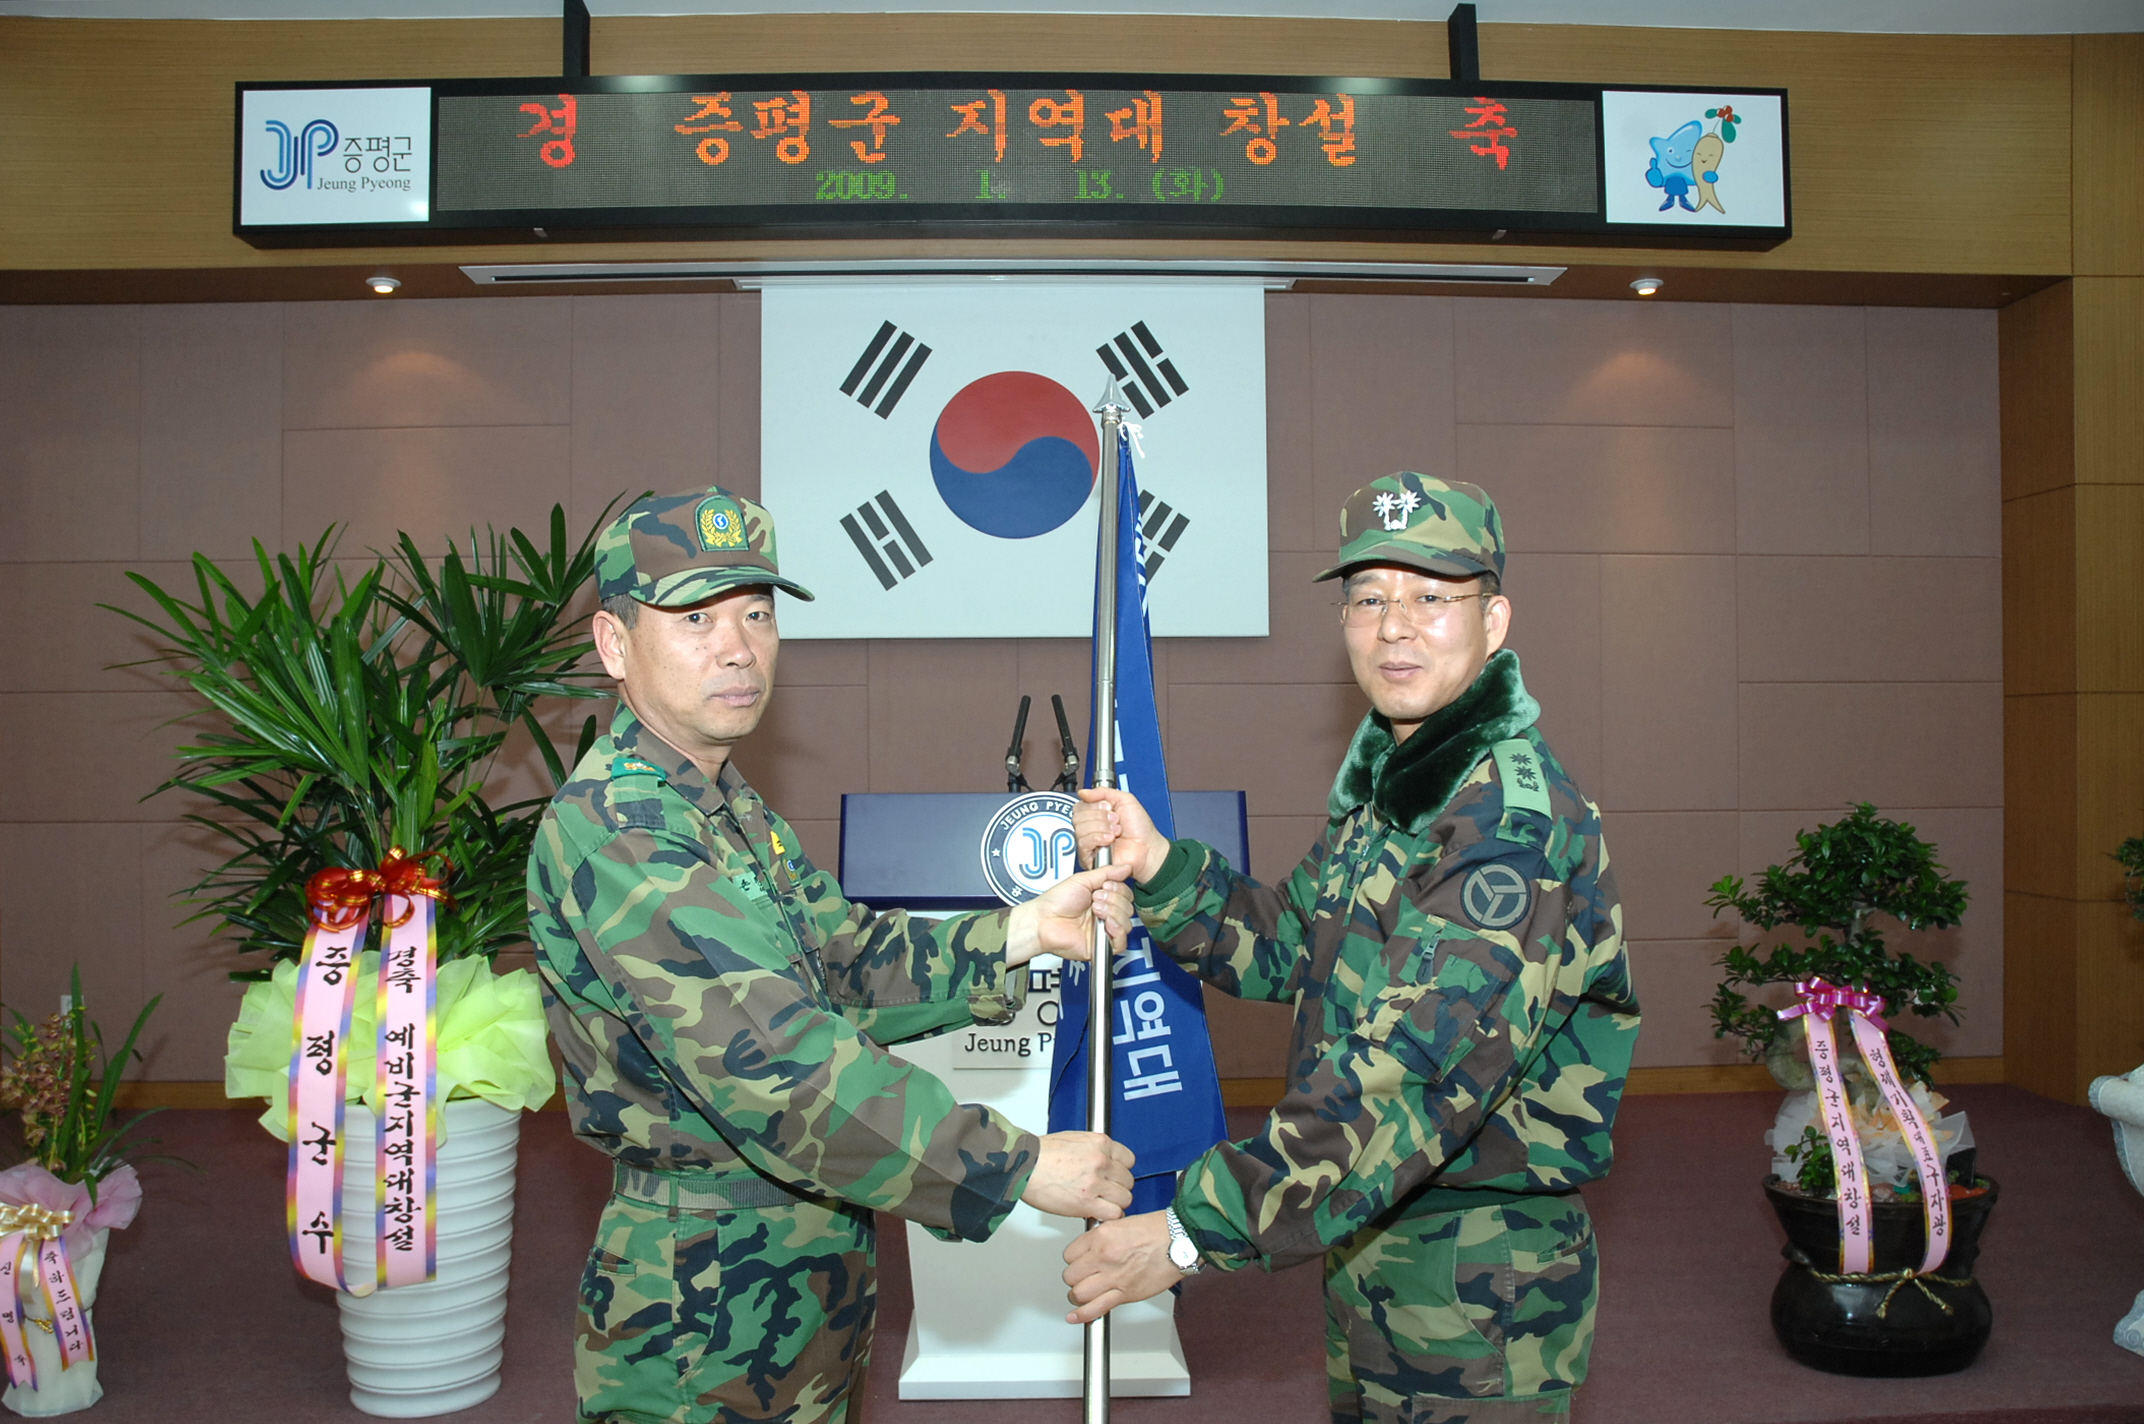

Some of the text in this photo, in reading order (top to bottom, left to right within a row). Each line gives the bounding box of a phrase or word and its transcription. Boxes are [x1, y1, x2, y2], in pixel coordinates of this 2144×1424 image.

[516, 89, 1518, 170] 경 증평군 지역대 창설 축
[343, 136, 412, 174] 증평군
[317, 176, 411, 193] Jeung Pyeong
[815, 170, 909, 200] 2009.
[1073, 169, 1125, 200] 13.
[1152, 166, 1225, 202] (화)
[1000, 801, 1039, 831] JEUNG
[385, 945, 422, 994] 경축
[964, 1032, 1032, 1058] Jeung
